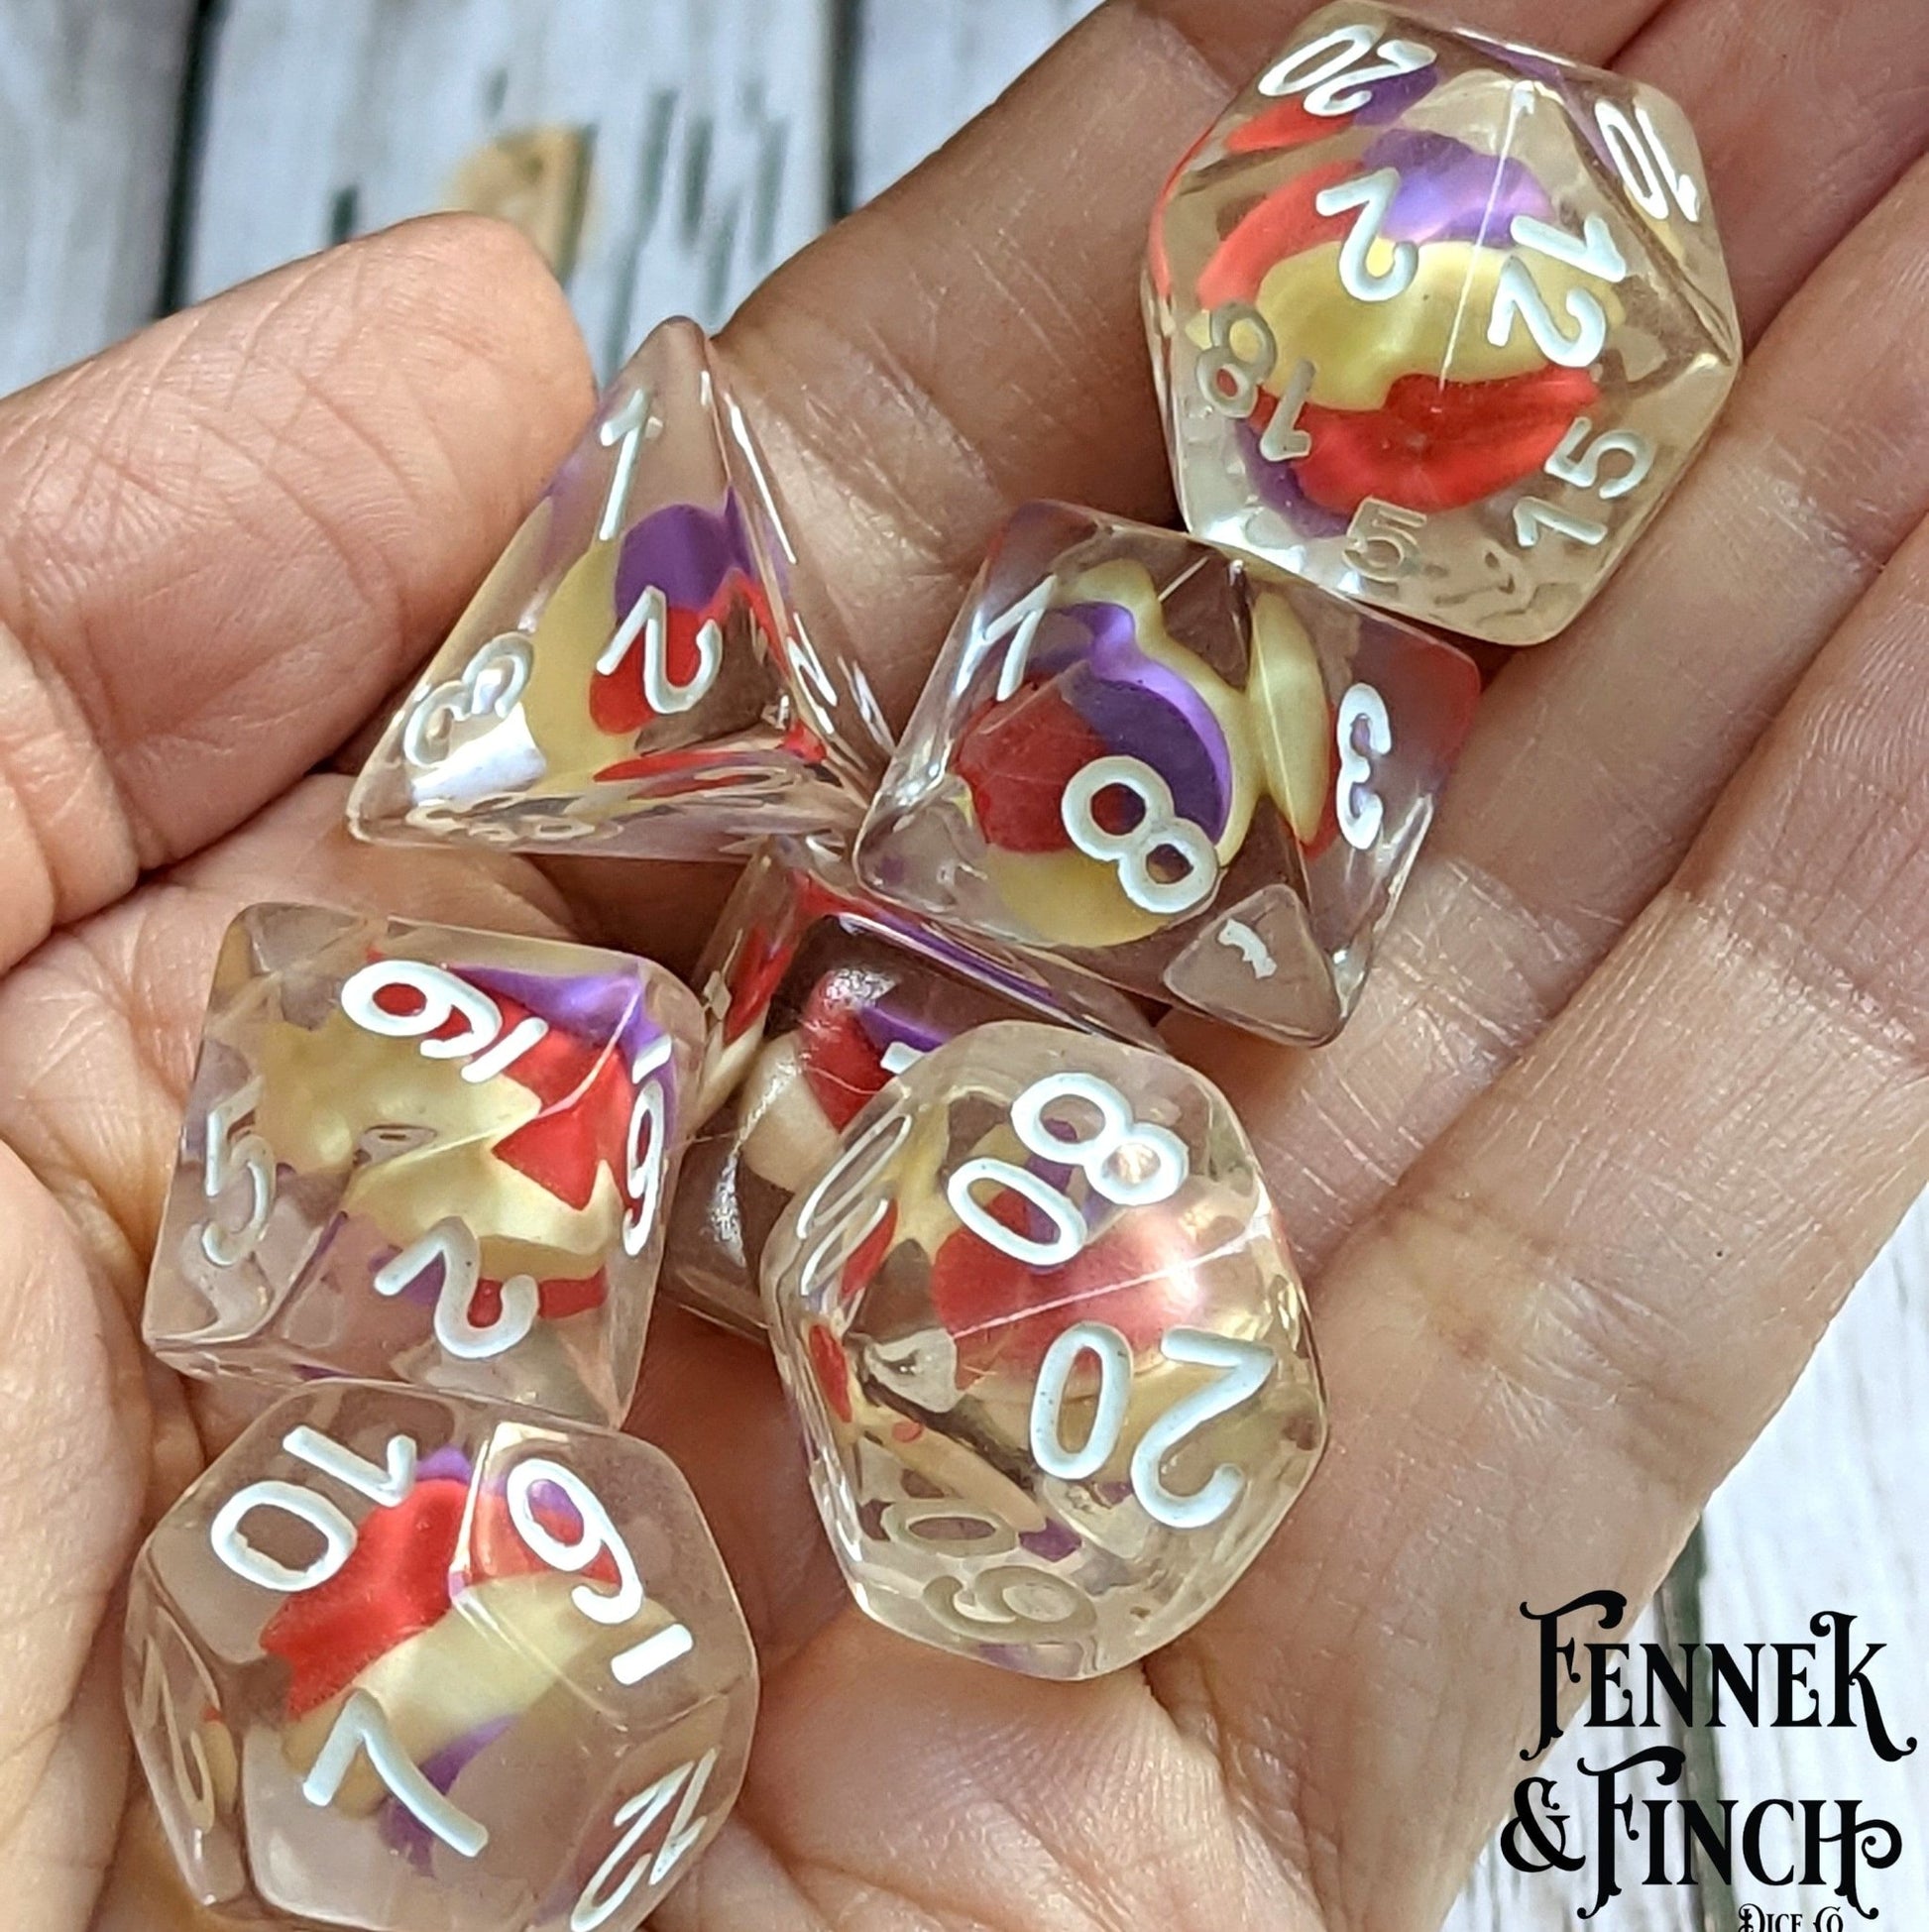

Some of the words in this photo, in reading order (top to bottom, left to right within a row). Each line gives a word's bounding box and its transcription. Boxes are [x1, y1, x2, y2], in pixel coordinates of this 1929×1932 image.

[1259, 25, 1437, 117] 20
[1316, 168, 1419, 301] 2
[1594, 99, 1701, 222] 10
[1487, 214, 1628, 368] 12
[1195, 301, 1317, 462] 18
[599, 388, 650, 540] 1
[1513, 416, 1655, 548] 15
[597, 585, 724, 714] 2
[1061, 755, 1219, 914] 8
[1336, 682, 1392, 850] 3
[201, 1076, 277, 1267] 5
[948, 1073, 1189, 1267] 80
[375, 1215, 539, 1359] 2
[1030, 1321, 1275, 1529] 20
[210, 1425, 417, 1592] 10
[302, 1687, 489, 1858] 7
